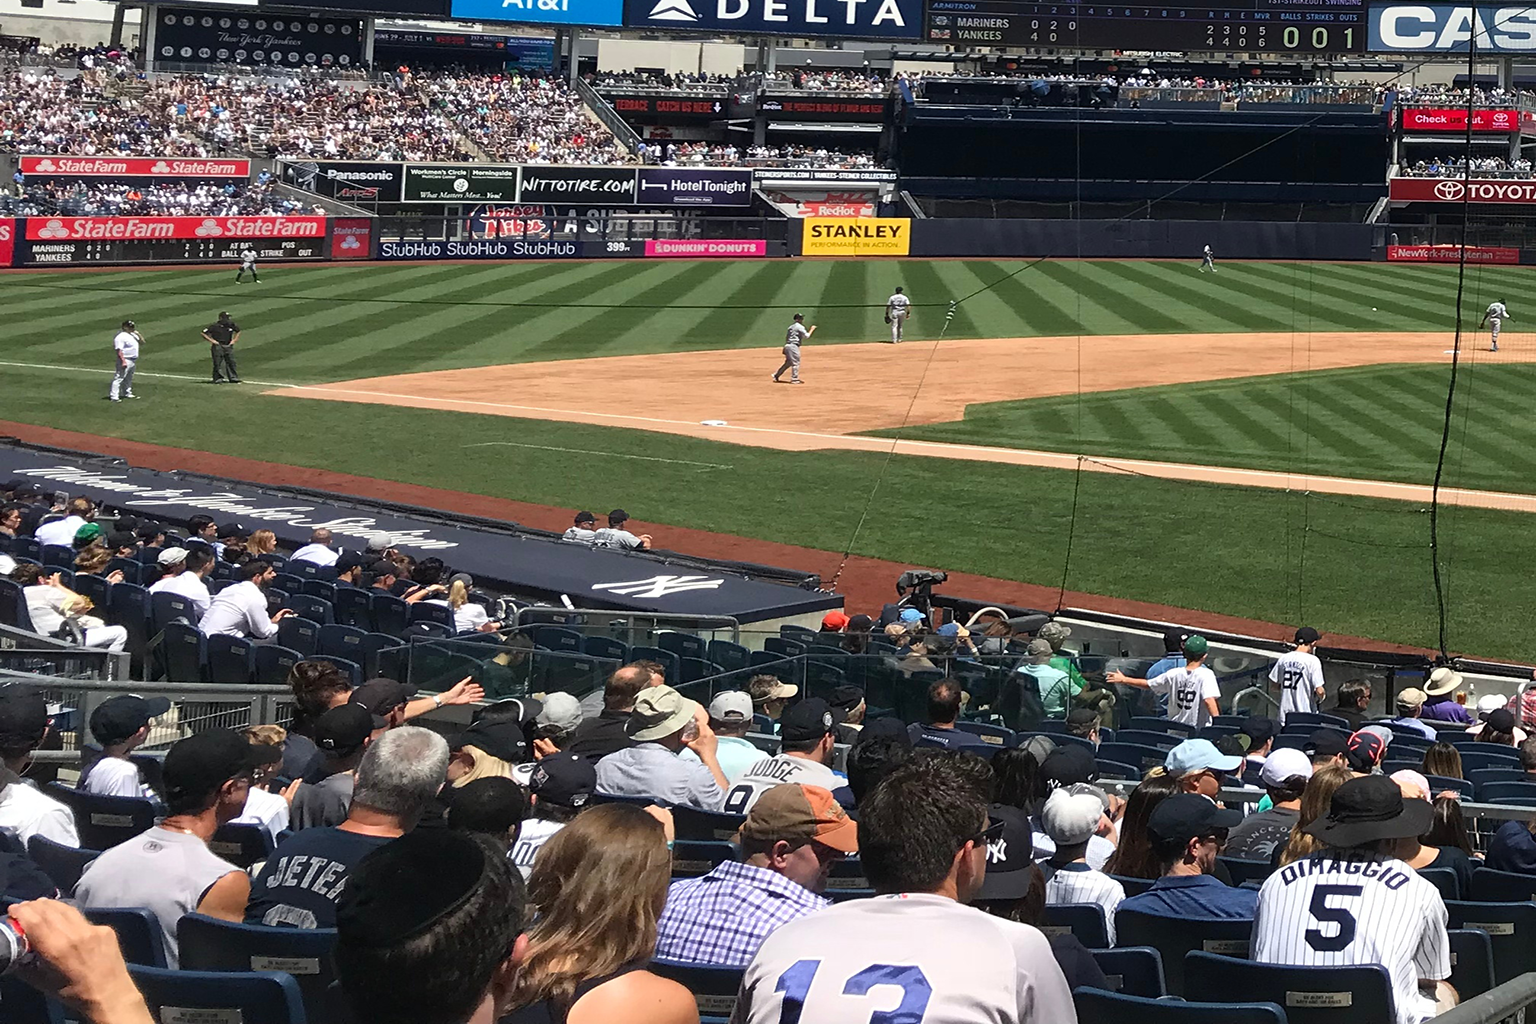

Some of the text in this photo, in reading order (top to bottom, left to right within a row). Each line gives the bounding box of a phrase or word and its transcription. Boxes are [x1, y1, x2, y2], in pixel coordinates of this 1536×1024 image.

[957, 17, 1010, 29] MARINERS
[957, 30, 1002, 41] YANKEES
[1283, 26, 1353, 49] 0 0 1
[1414, 114, 1447, 124] Check
[327, 169, 393, 181] Panasonic
[521, 176, 635, 194] NITTOTIRE.COM
[811, 225, 902, 238] STANLEY
[31, 244, 76, 253] MARINERS
[381, 241, 576, 257] StubHub StubHub StubHub
[607, 242, 624, 252] 399
[663, 243, 757, 253] DUNKIN' DONUTS
[35, 253, 72, 262] YANKEES
[1282, 670, 1304, 690] 27
[743, 757, 802, 782] JUDGE
[1281, 851, 1410, 890] DIMAGGIO
[1304, 883, 1364, 952] 5
